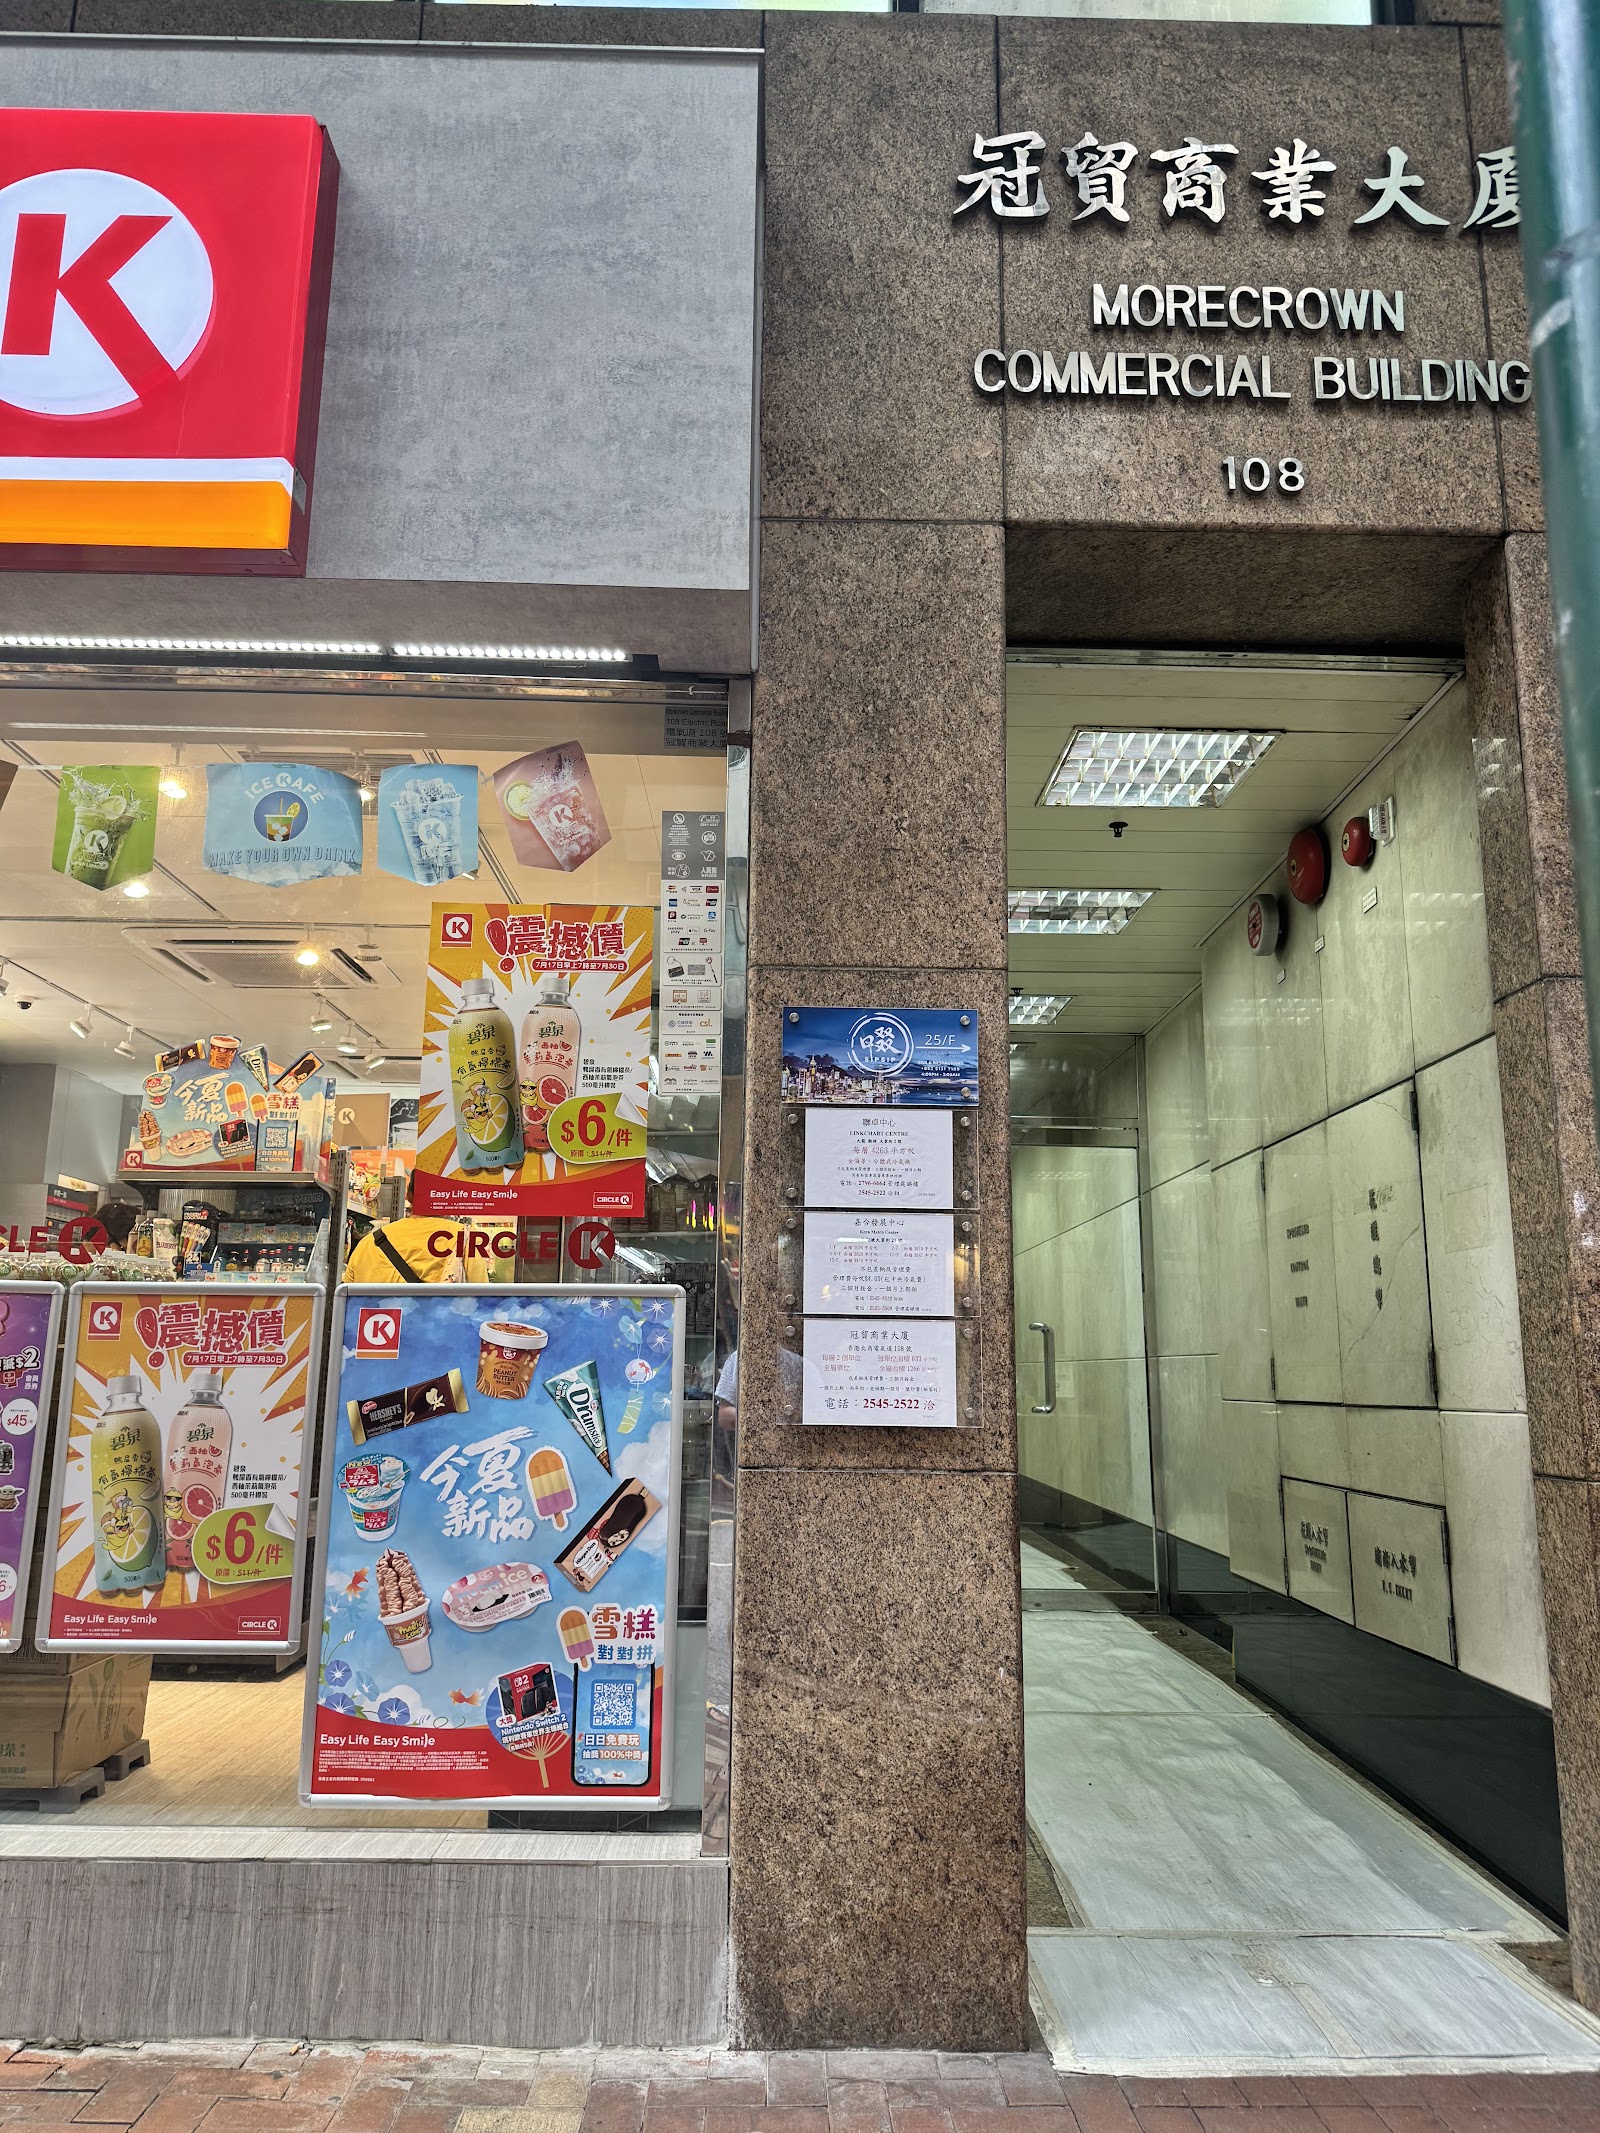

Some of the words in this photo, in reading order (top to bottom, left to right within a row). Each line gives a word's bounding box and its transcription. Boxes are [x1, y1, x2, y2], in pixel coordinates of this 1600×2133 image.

[1, 213, 176, 399] K
[1092, 283, 1405, 332] MORECROWN
[973, 348, 1292, 399] COMMERCIAL
[1313, 356, 1533, 403] BUILDING
[1221, 455, 1306, 493] 108
[667, 718, 680, 726] 108
[682, 718, 709, 727] Electric
[699, 729, 717, 737] 108
[244, 776, 274, 800] ICE
[209, 850, 242, 867] MAKE
[246, 847, 280, 864] YOUR
[282, 846, 311, 862] OWN
[314, 845, 356, 864] DRINK
[925, 1034, 956, 1046] 25/F
[430, 1190, 451, 1199] Easy
[452, 1189, 469, 1198] Life
[471, 1190, 493, 1199] Easy
[596, 1196, 620, 1204] CIRCLE
[427, 1230, 558, 1258] CIRCLE
[863, 1398, 919, 1409] 2545-2522
[205, 1511, 284, 1565] $6/件
[63, 1614, 87, 1624] Easy
[87, 1614, 104, 1624] Life
[107, 1614, 130, 1624] Easy
[241, 1620, 266, 1629] CIRCLE
[592, 1606, 656, 1640] 雪糕
[597, 1644, 654, 1660] 對對拼
[500, 1721, 535, 1736] Nintendo
[535, 1715, 560, 1728] Switch
[560, 1714, 567, 1722] 2
[320, 1734, 347, 1746] Easy
[348, 1734, 370, 1745] Life
[373, 1735, 401, 1748] Easy
[584, 1733, 640, 1747] 日日免費玩
